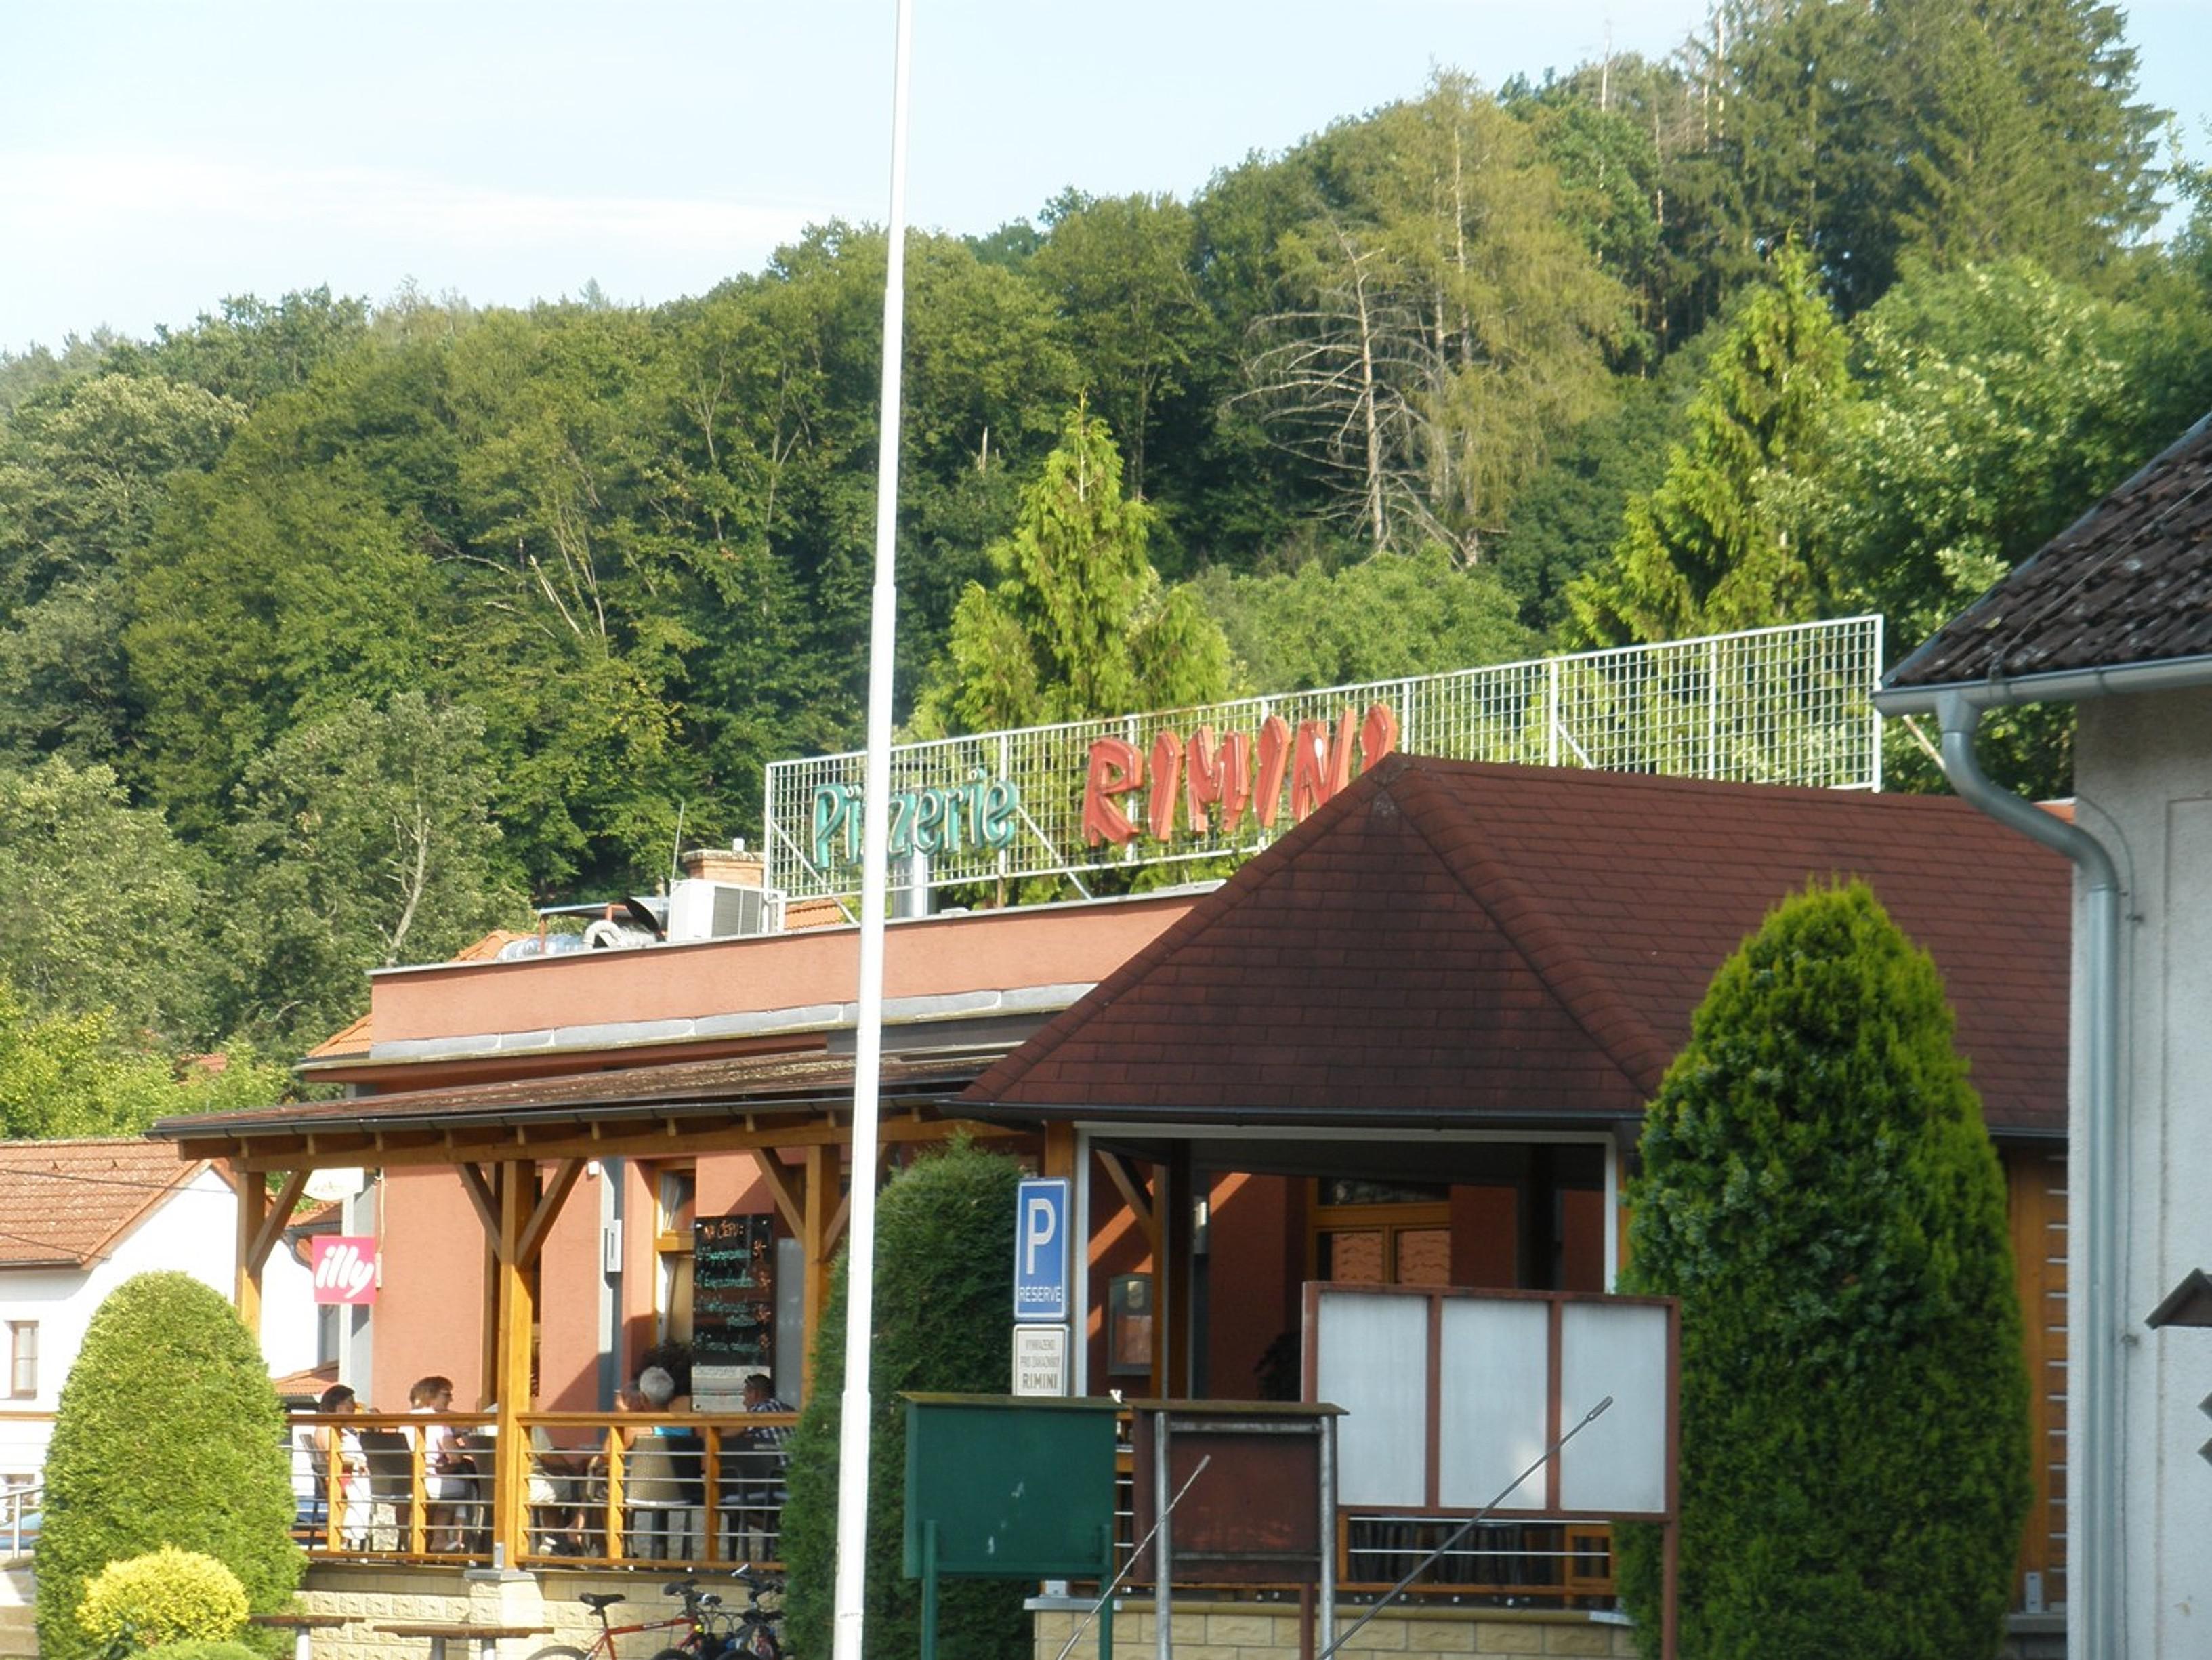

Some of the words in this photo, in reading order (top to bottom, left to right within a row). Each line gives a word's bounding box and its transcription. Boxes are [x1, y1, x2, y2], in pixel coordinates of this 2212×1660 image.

[813, 764, 1018, 869] Pizerie
[1026, 1198, 1056, 1274] P
[316, 1244, 375, 1299] illy
[1022, 1373, 1058, 1390] RIMINI
